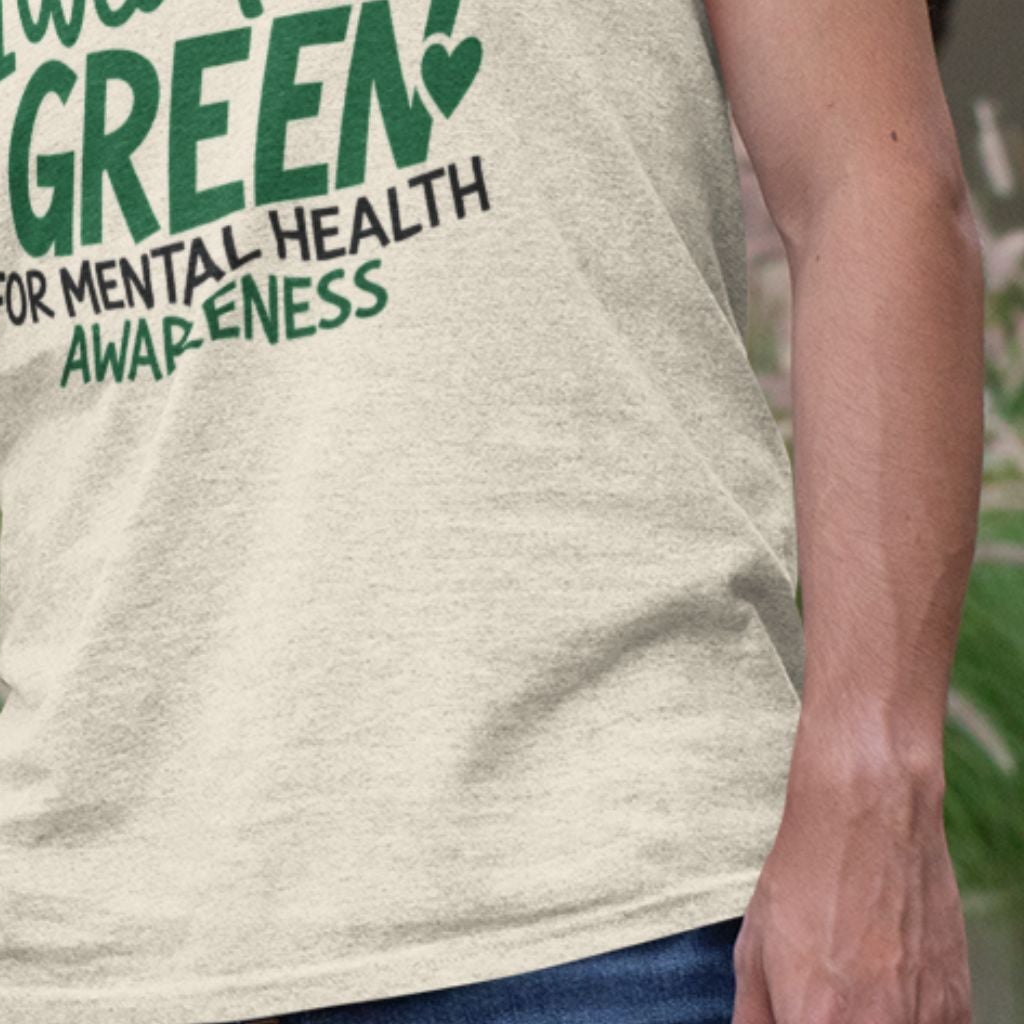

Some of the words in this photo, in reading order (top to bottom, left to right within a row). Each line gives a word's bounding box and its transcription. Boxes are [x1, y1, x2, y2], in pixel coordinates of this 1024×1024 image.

[60, 225, 261, 318] MENTAL
[269, 155, 490, 261] HEALTH
[60, 259, 389, 388] AWARENESS
